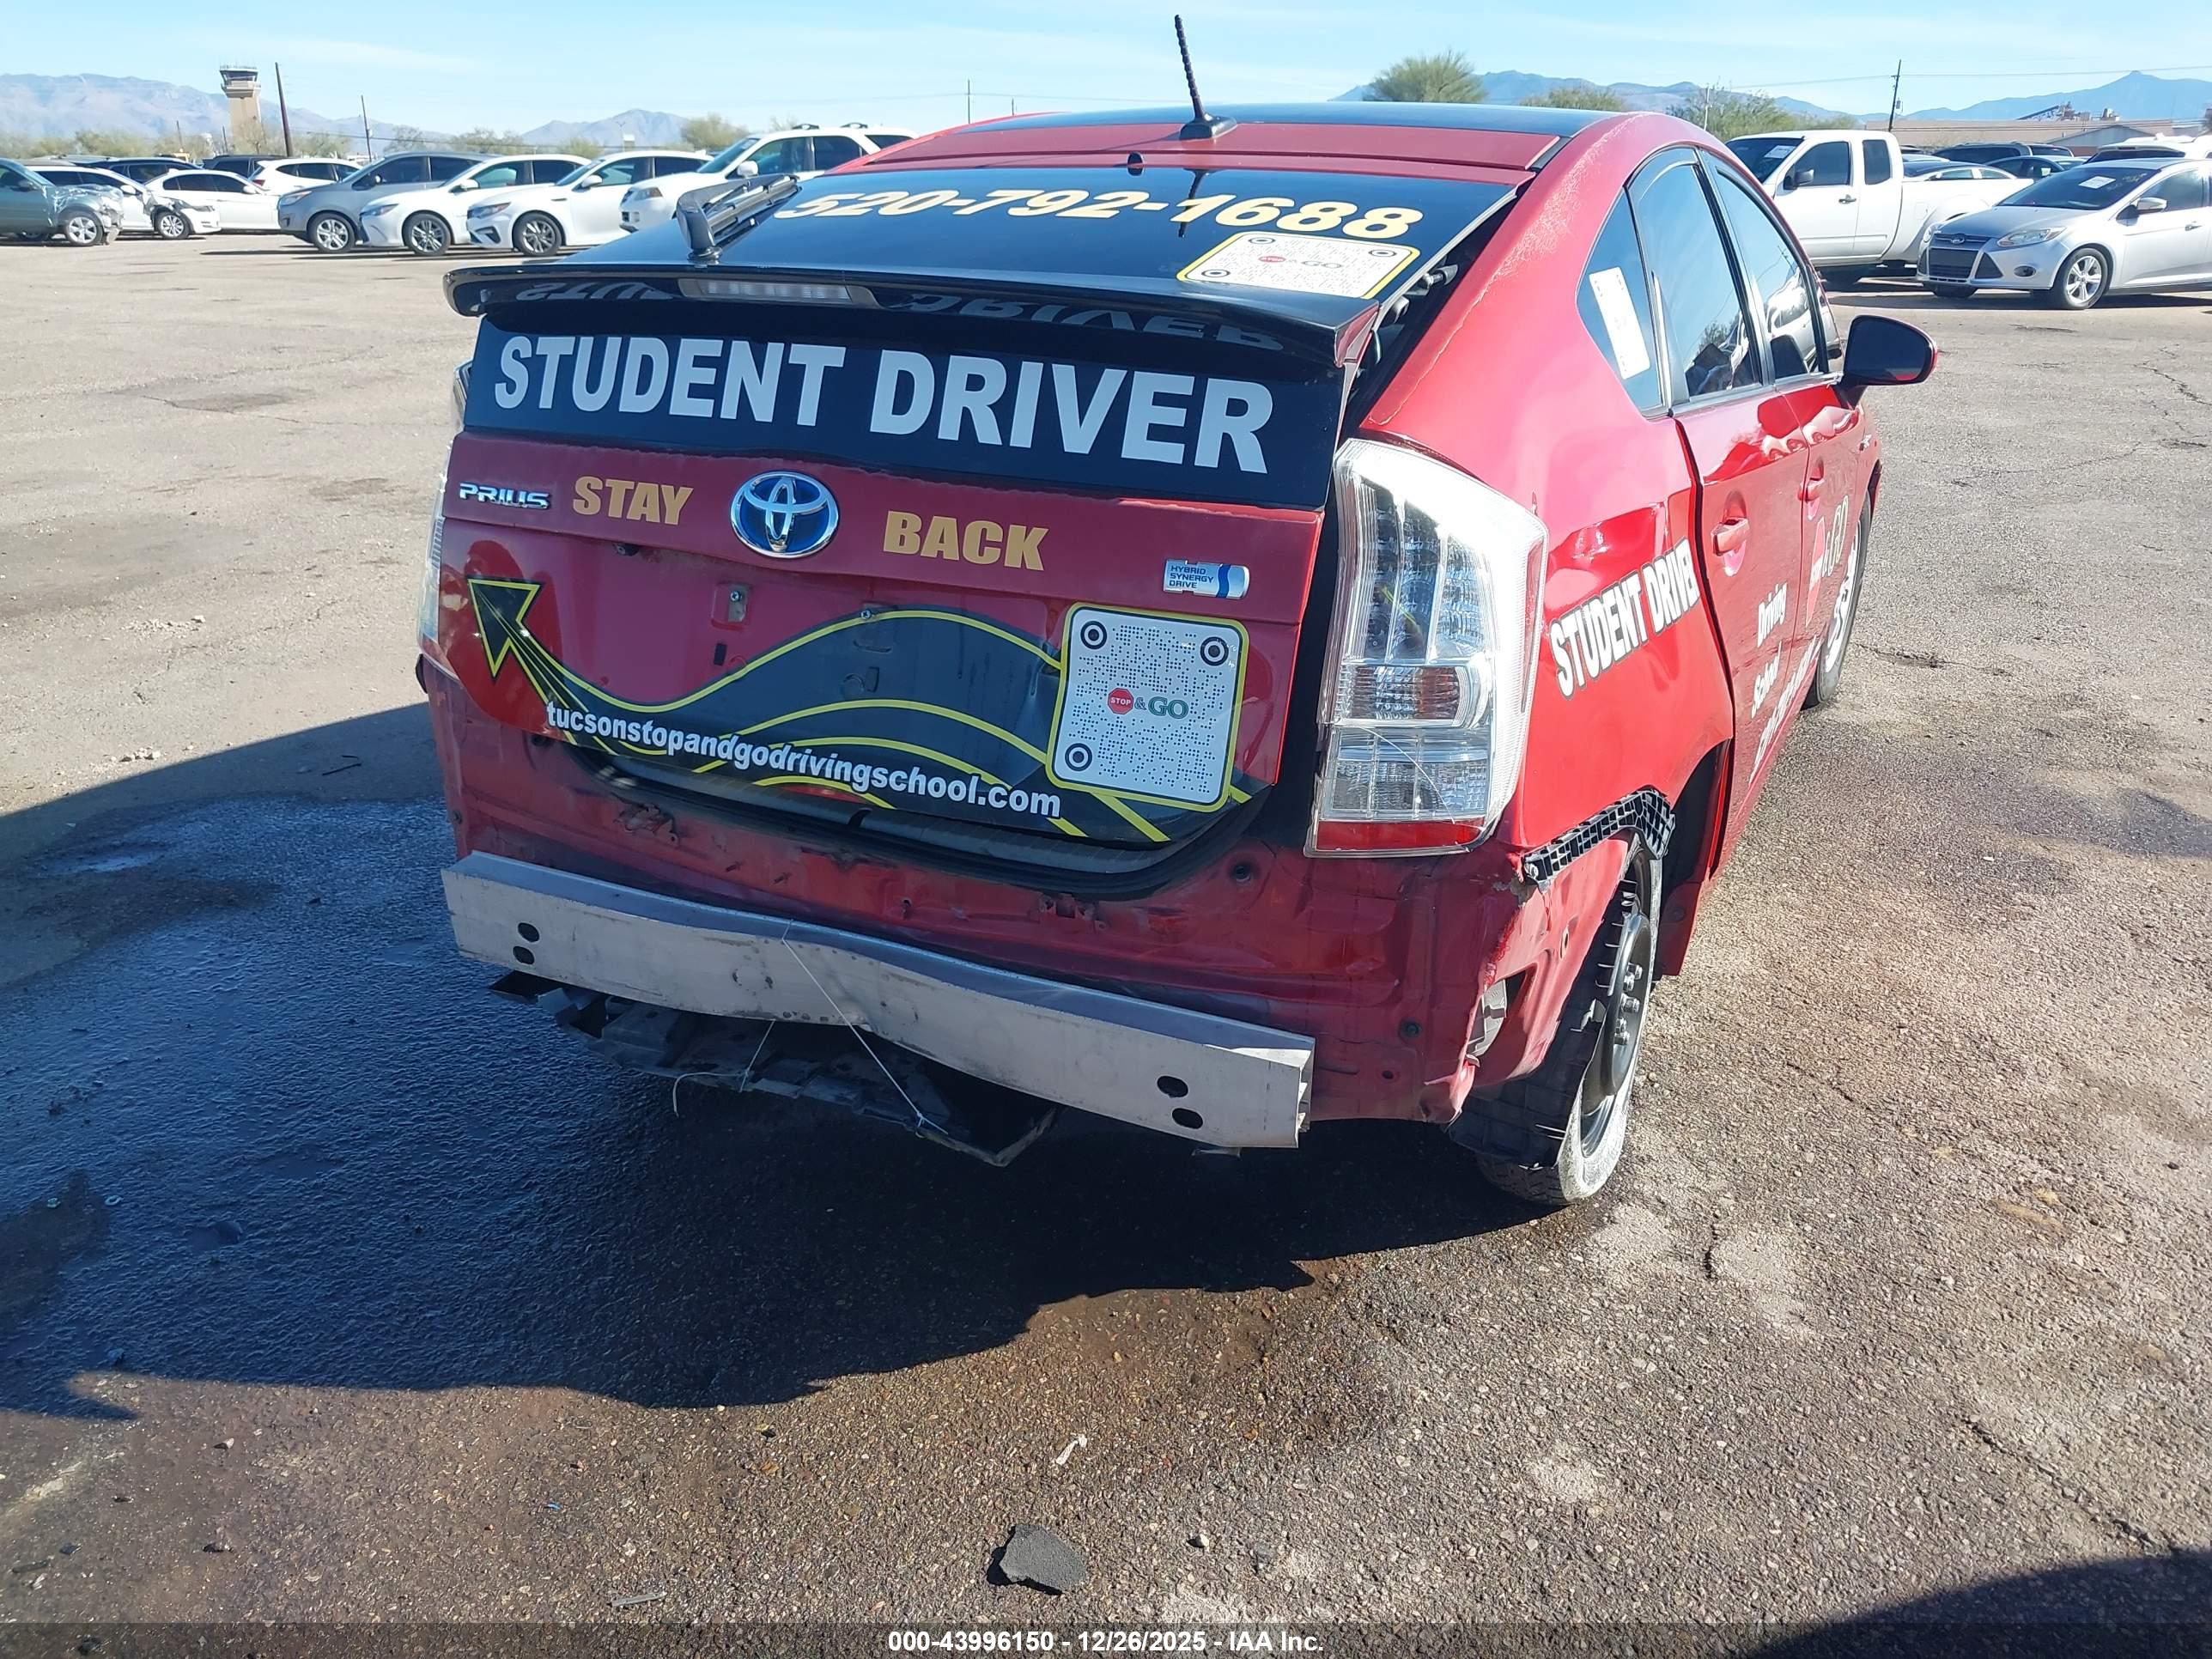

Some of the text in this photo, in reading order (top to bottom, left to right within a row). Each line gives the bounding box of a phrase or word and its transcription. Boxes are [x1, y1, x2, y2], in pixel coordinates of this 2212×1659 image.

[775, 189, 1423, 239] 520-792-1688
[495, 336, 1273, 474] STUDENT DRIVER
[459, 483, 551, 509] PRIUS
[573, 476, 1048, 571] STAY BACK
[1169, 580, 1198, 589] DRIVE
[1170, 565, 1206, 574] HYBRID
[1170, 573, 1214, 583] SYNERGY
[1549, 569, 1649, 701] STUDENT
[1110, 696, 1188, 719] STOP & GO
[547, 699, 1061, 817] tucsonstopandgodrivingschool.com
